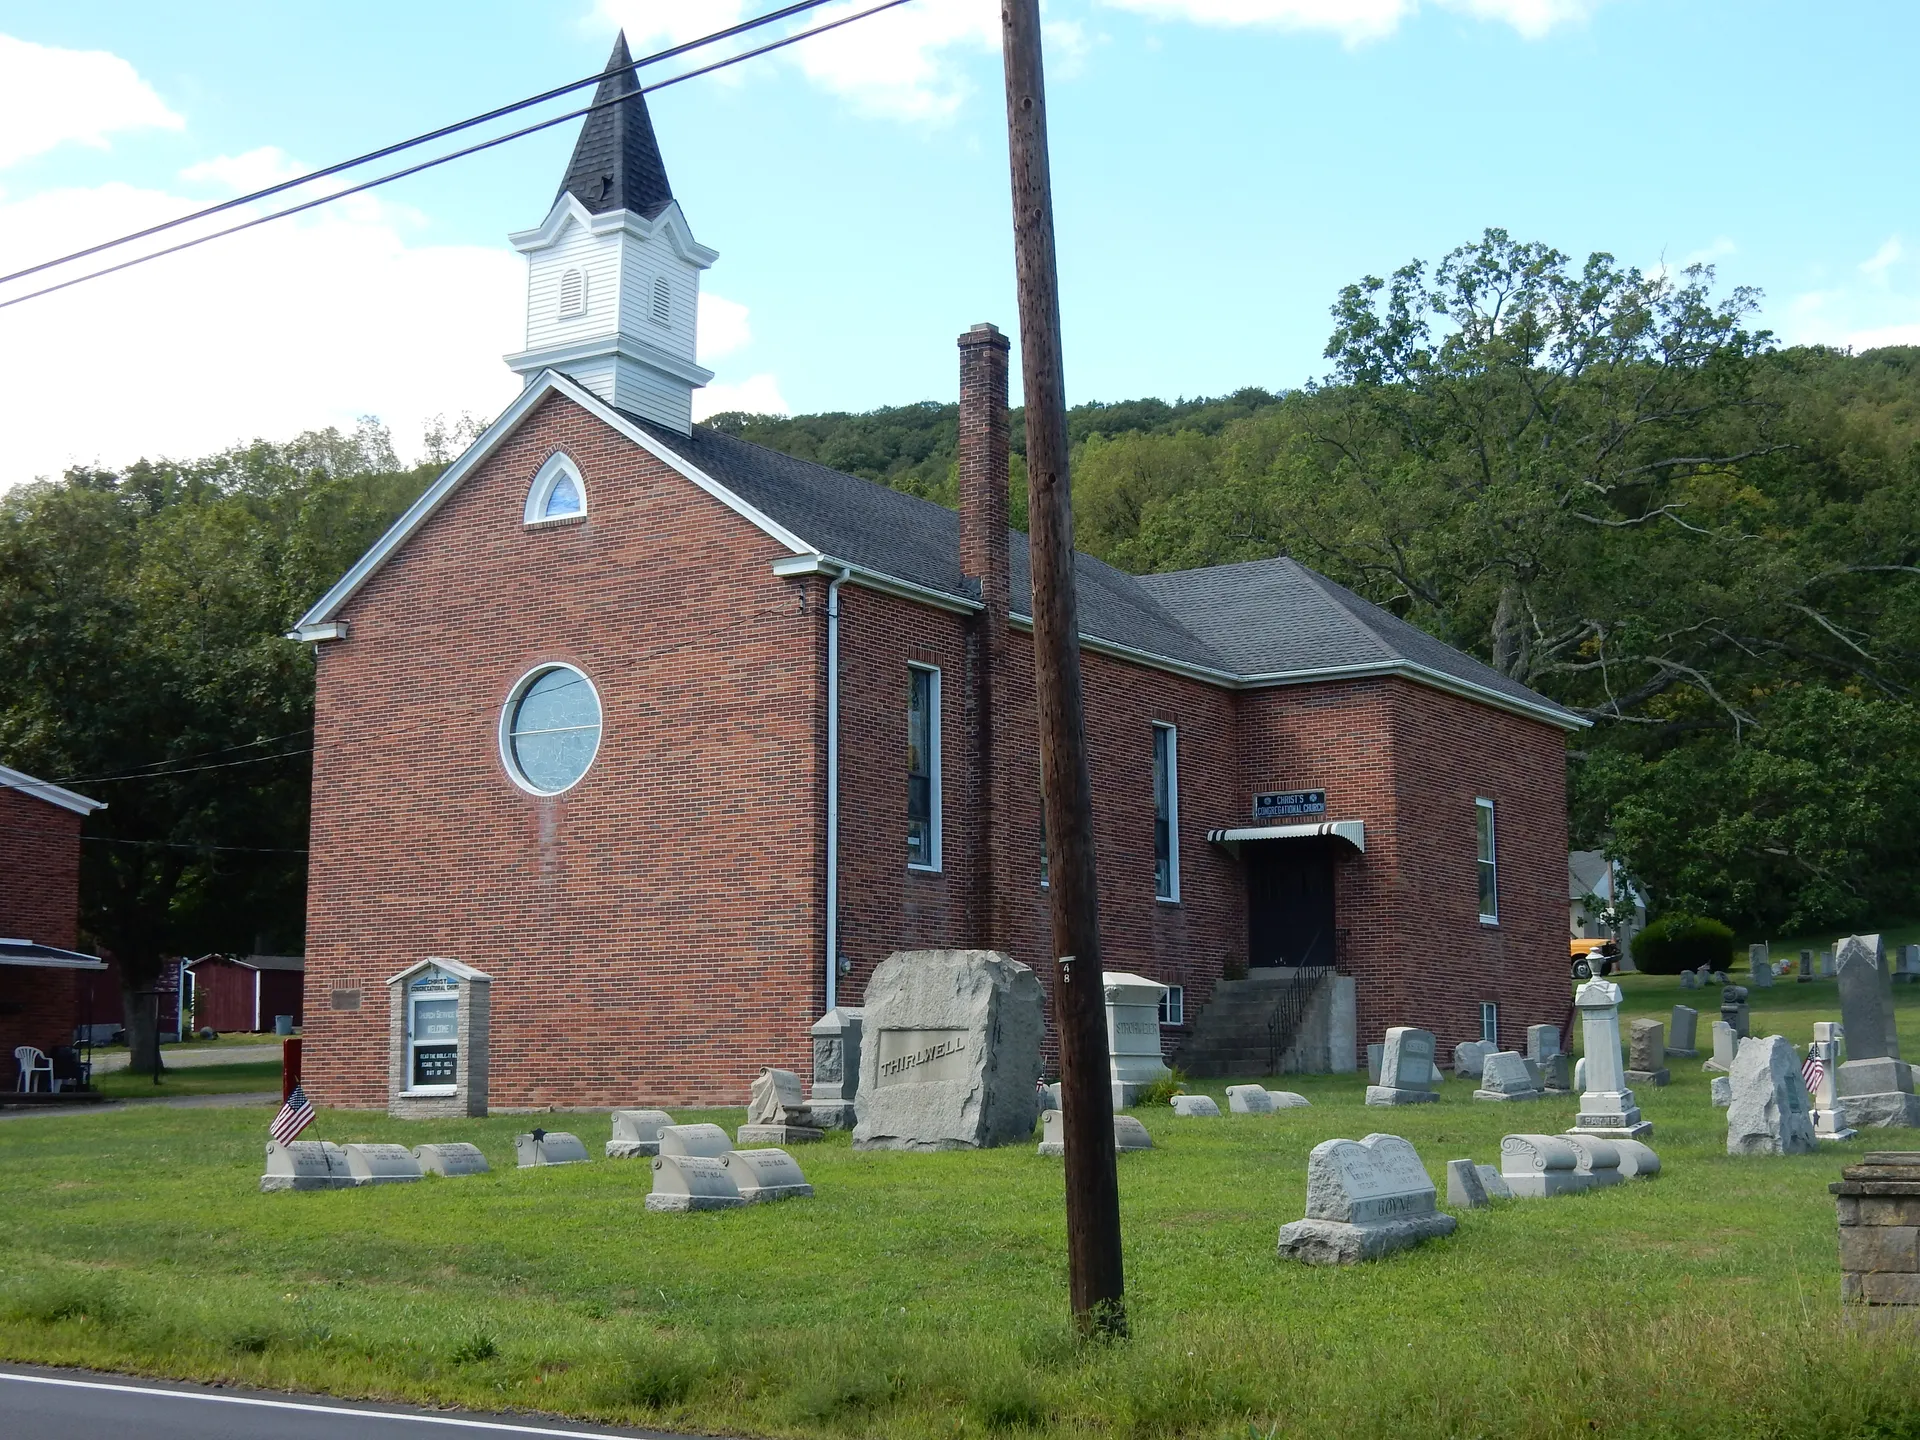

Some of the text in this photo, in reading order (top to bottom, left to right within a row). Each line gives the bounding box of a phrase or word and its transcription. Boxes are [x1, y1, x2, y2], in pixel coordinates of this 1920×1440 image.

[1277, 795, 1303, 804] CHRIST'S
[1258, 803, 1324, 815] CONGREGATIONAL CHURCH
[881, 1038, 965, 1077] THIRLWELL
[1584, 1116, 1618, 1125] PAYNE
